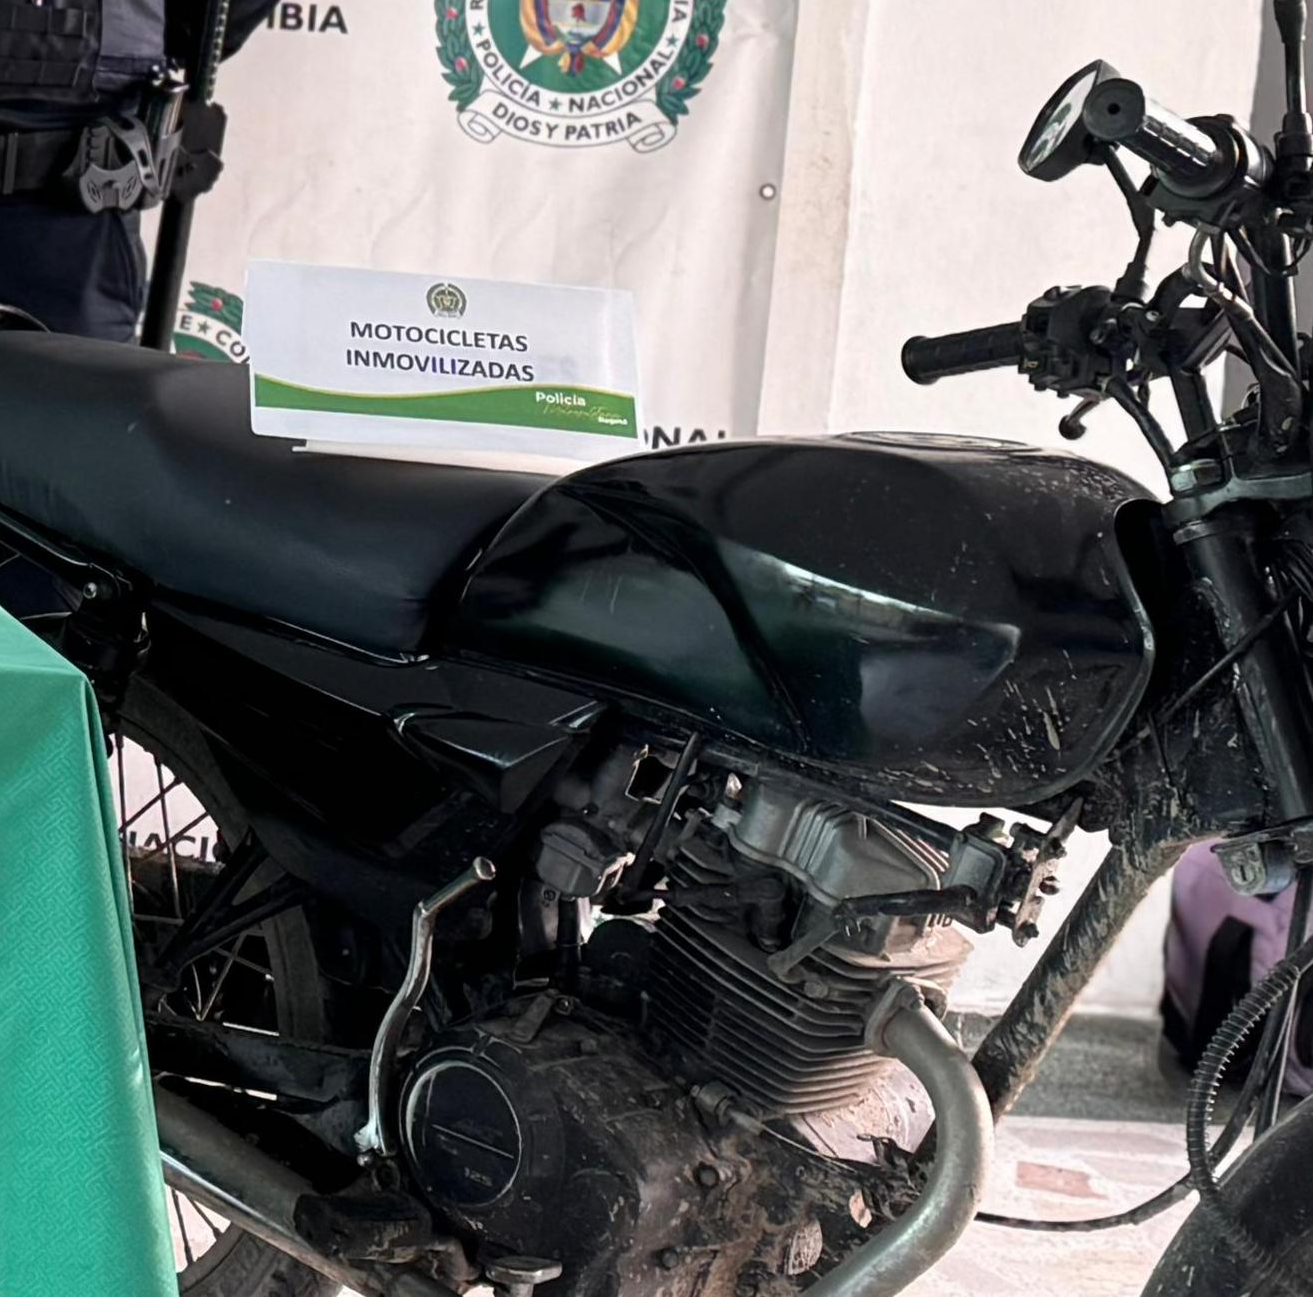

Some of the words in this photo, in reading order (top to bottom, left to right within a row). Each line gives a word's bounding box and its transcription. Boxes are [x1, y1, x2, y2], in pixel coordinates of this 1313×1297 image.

[569, 52, 674, 111] NACIONAL
[565, 112, 642, 141] PATRIA
[351, 322, 527, 352] MOTOCICLETAS
[347, 350, 534, 381] INMOVILIZADAS
